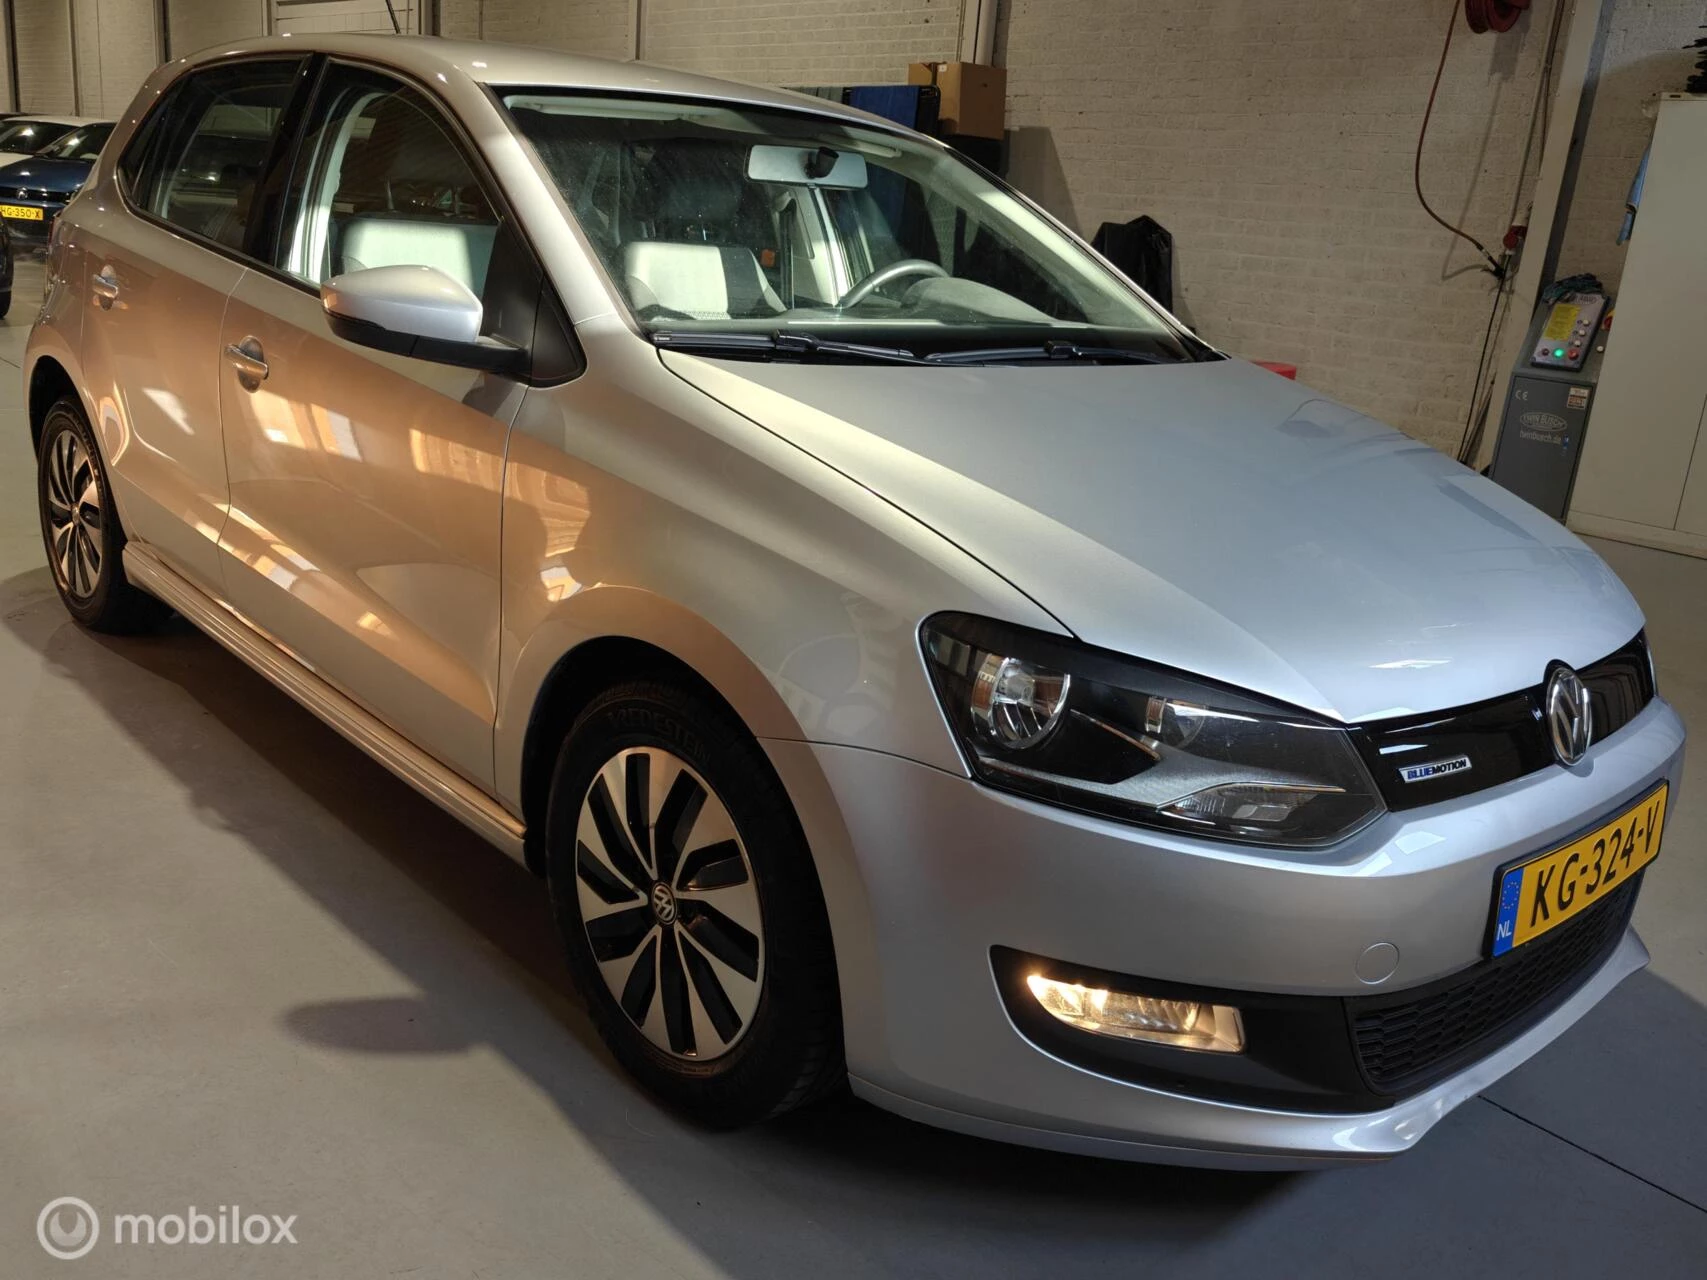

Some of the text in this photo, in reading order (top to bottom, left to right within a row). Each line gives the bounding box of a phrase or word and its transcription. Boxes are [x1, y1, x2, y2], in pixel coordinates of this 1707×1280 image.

[1407, 758, 1468, 781] BLUEMOTION
[1530, 800, 1662, 928] KG-324-V
[1496, 919, 1513, 942] NL
